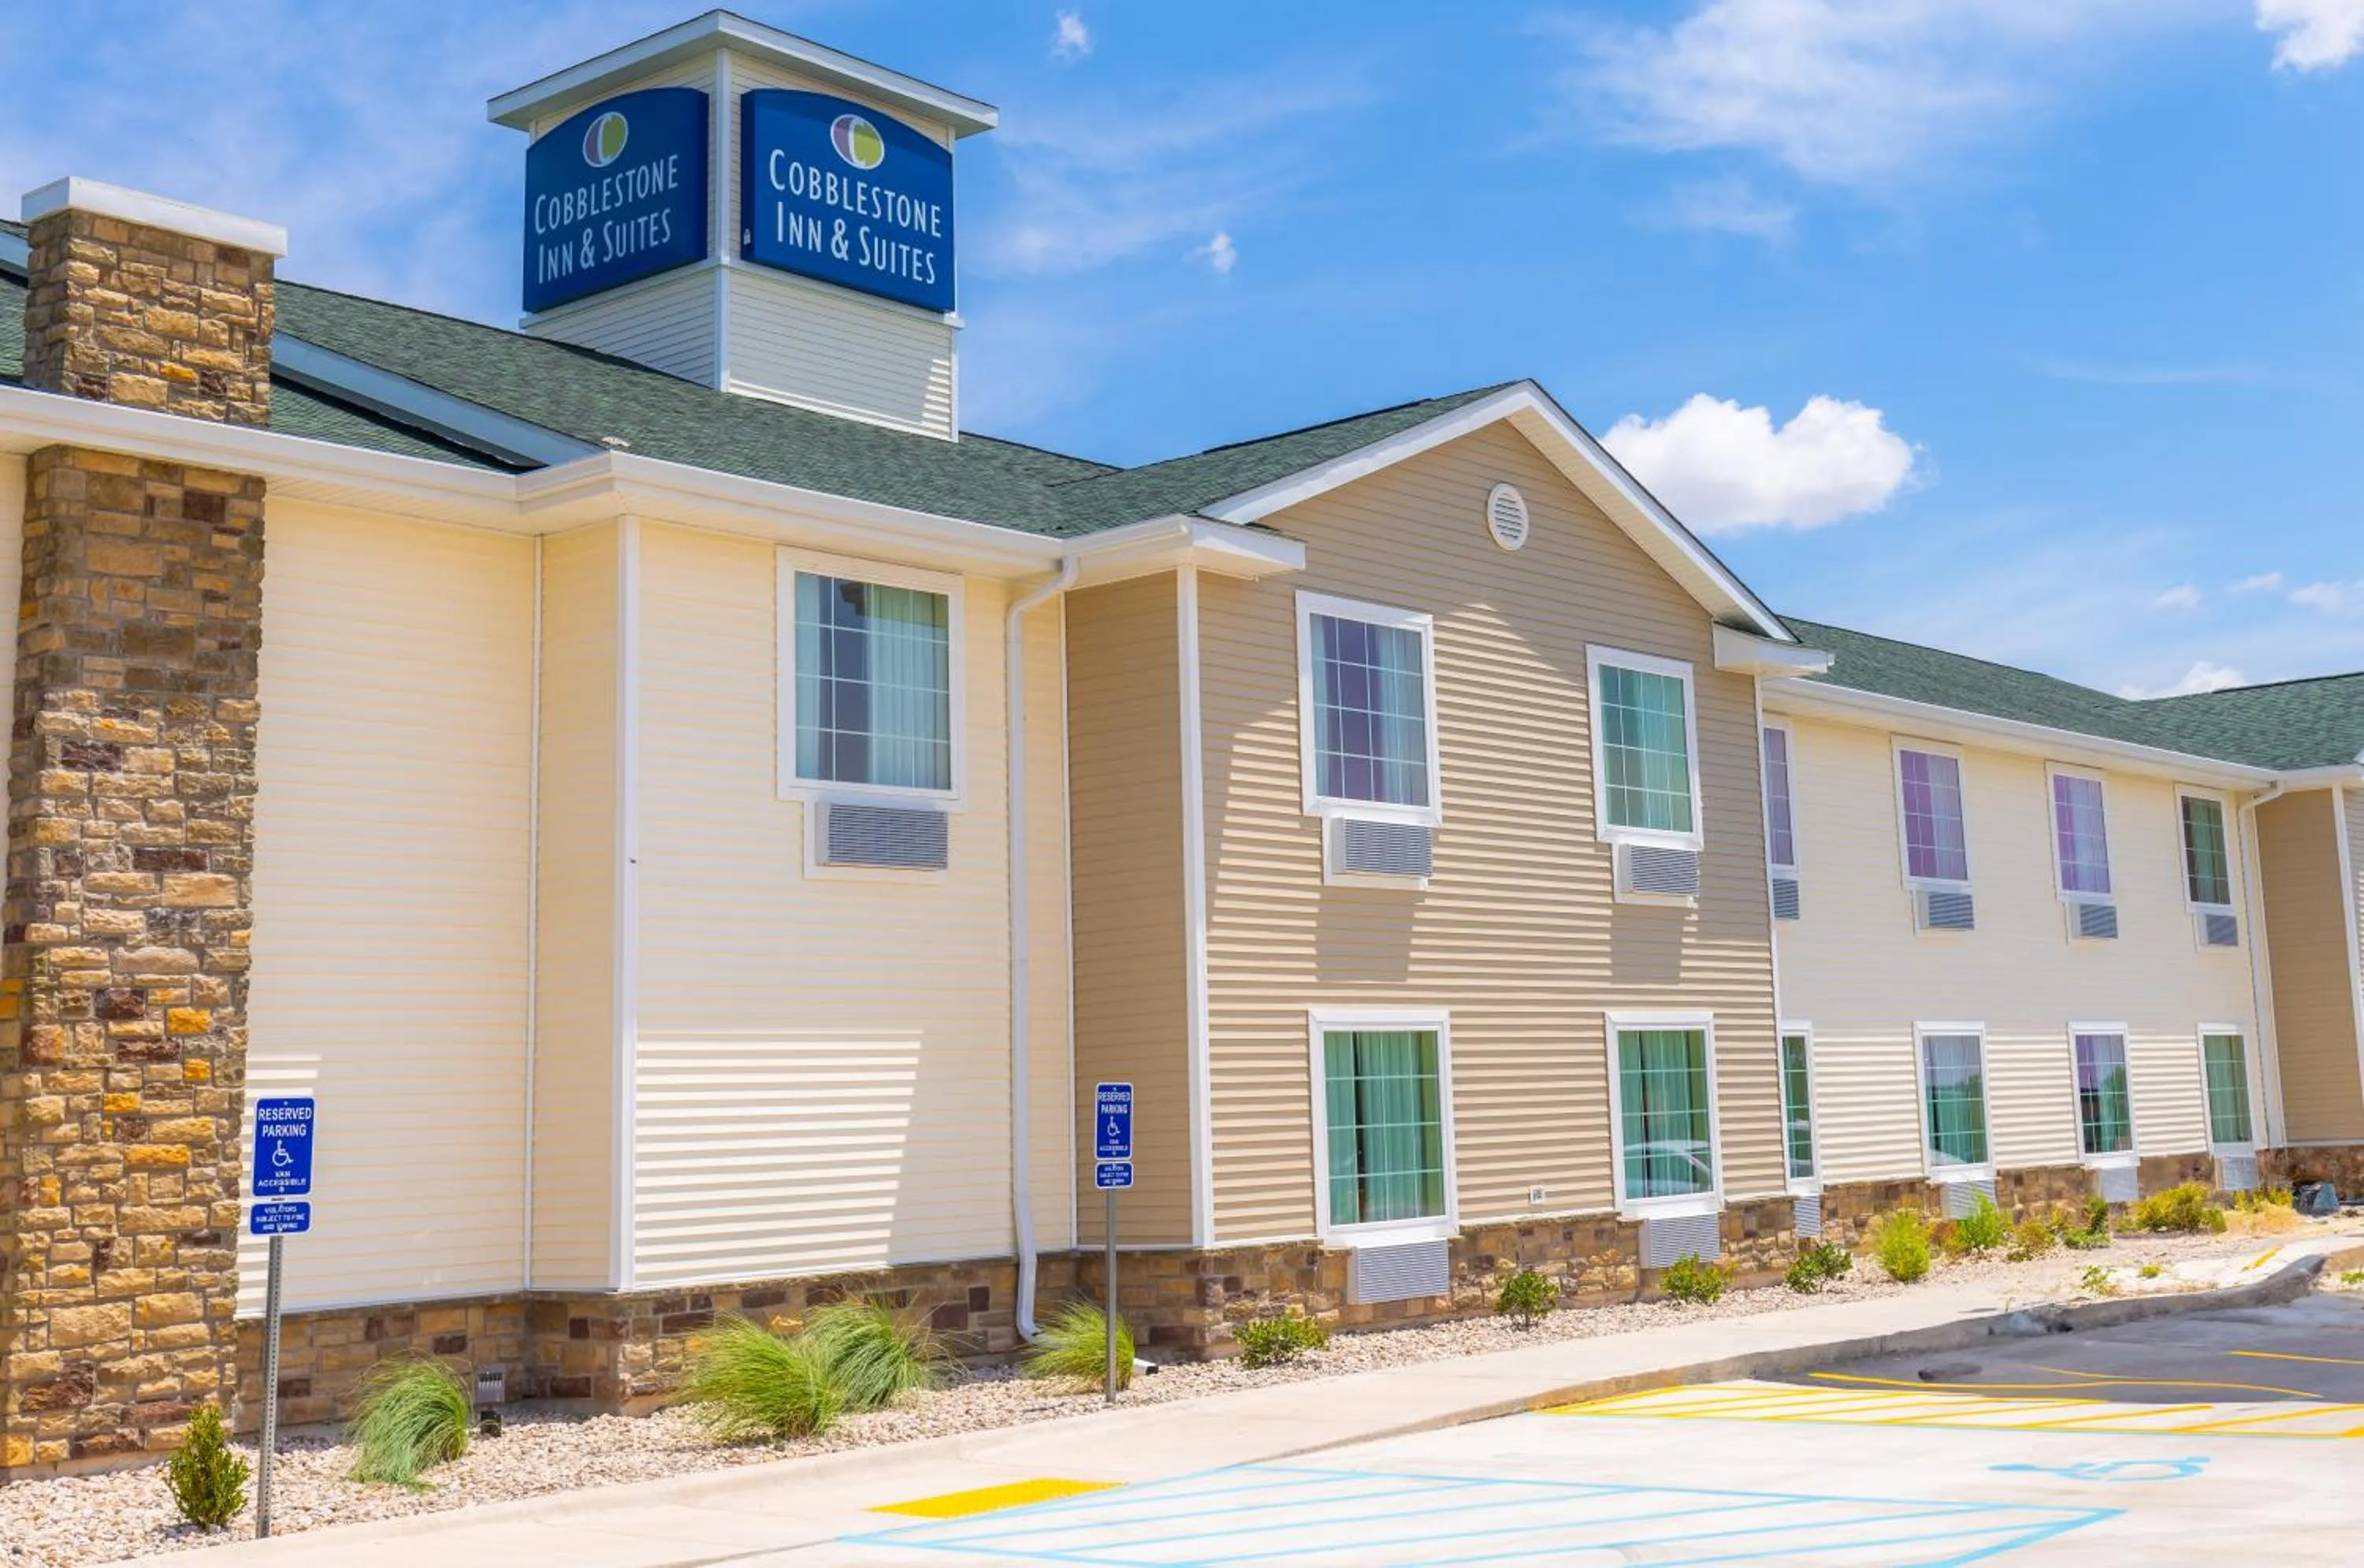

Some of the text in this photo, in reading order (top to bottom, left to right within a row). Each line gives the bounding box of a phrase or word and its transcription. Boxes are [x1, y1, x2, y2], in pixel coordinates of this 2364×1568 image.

[534, 154, 678, 235] COBBLESTONE
[769, 149, 942, 238] COBBLESTONE
[537, 208, 671, 284] INN & SUITES
[776, 201, 936, 285] INN & SUITES
[258, 1107, 312, 1120] RESERVED
[262, 1124, 307, 1137] PARKING
[258, 1178, 307, 1187] ACCESSIBLE
